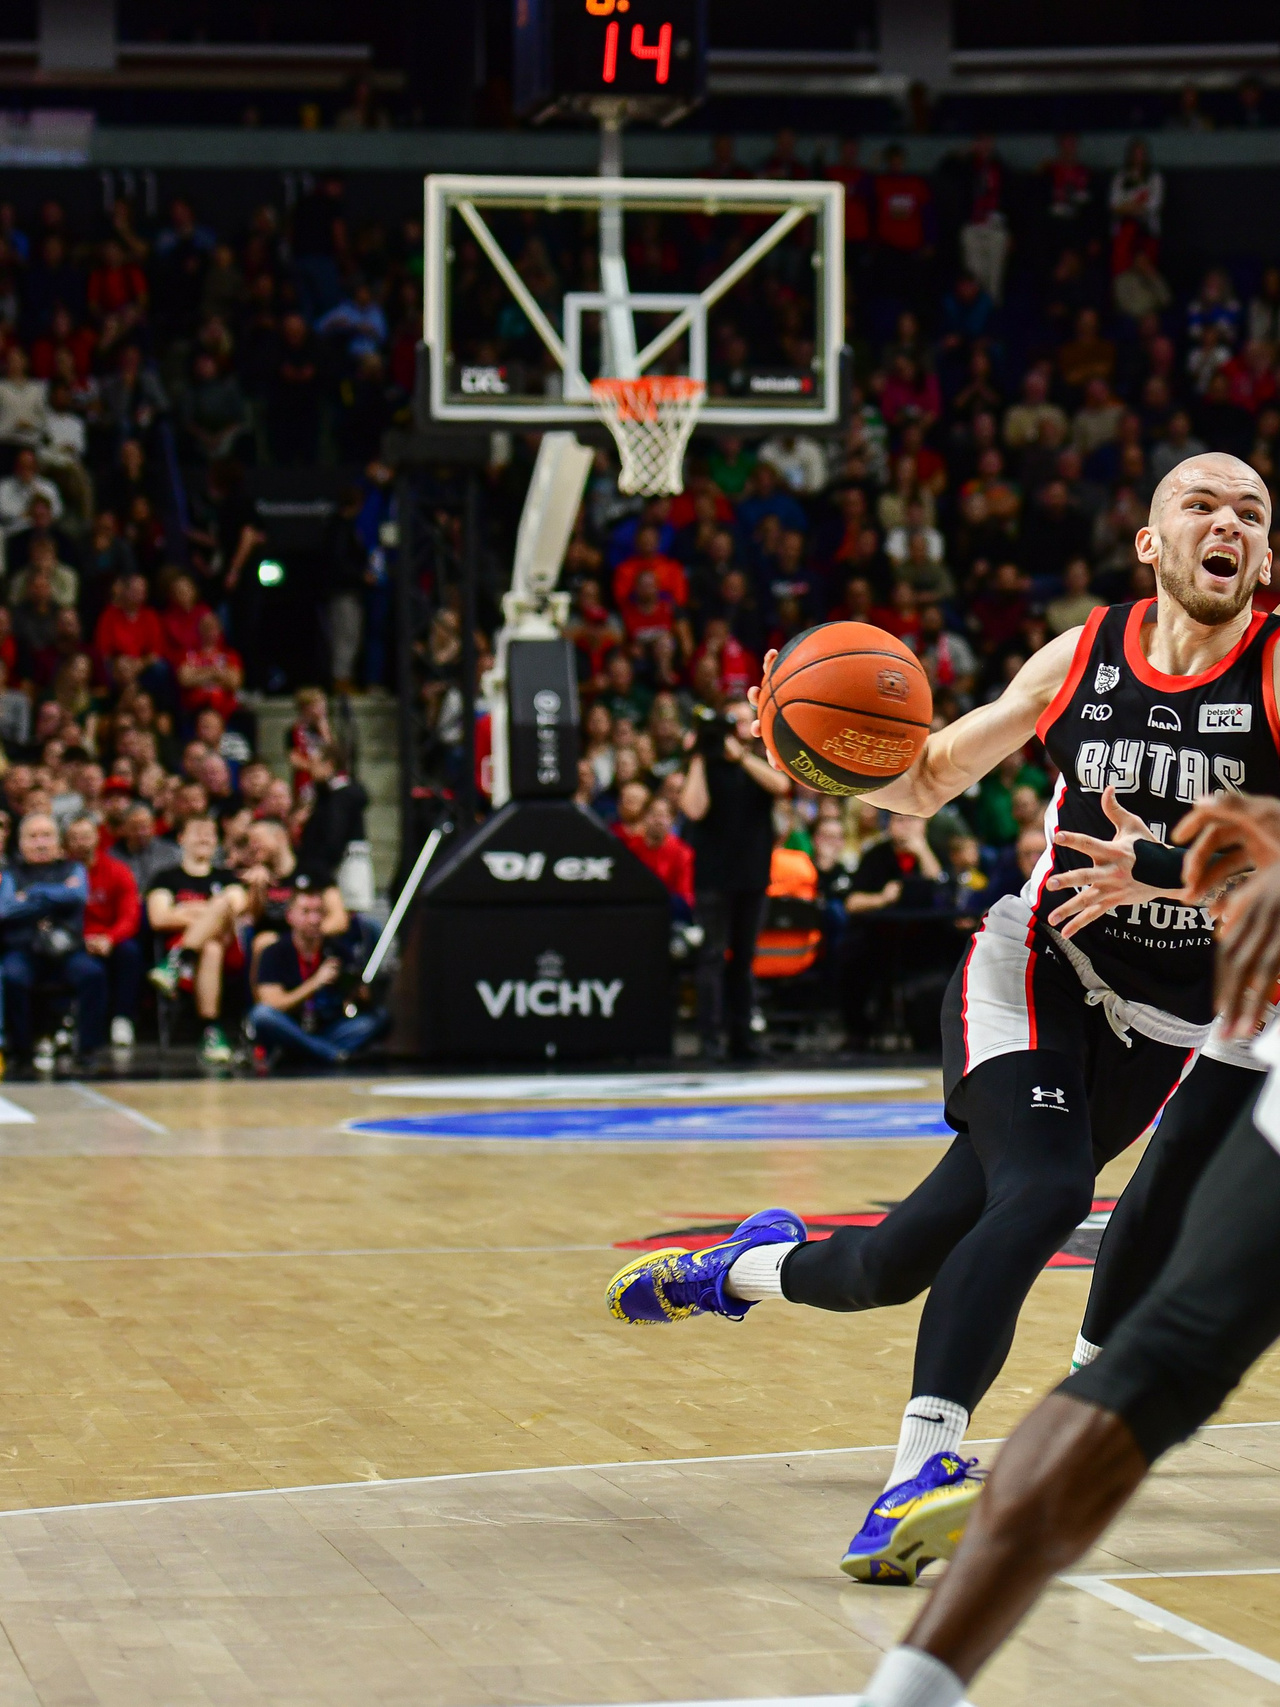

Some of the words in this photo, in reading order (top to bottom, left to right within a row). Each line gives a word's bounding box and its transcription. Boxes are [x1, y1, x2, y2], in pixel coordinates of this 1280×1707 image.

[603, 21, 672, 84] 14
[1206, 716, 1243, 727] LKL
[1207, 708, 1236, 716] betsafe
[1076, 738, 1246, 804] RYTAS
[1104, 927, 1212, 949] ALKOHOLINIS
[476, 979, 624, 1018] VICHY
